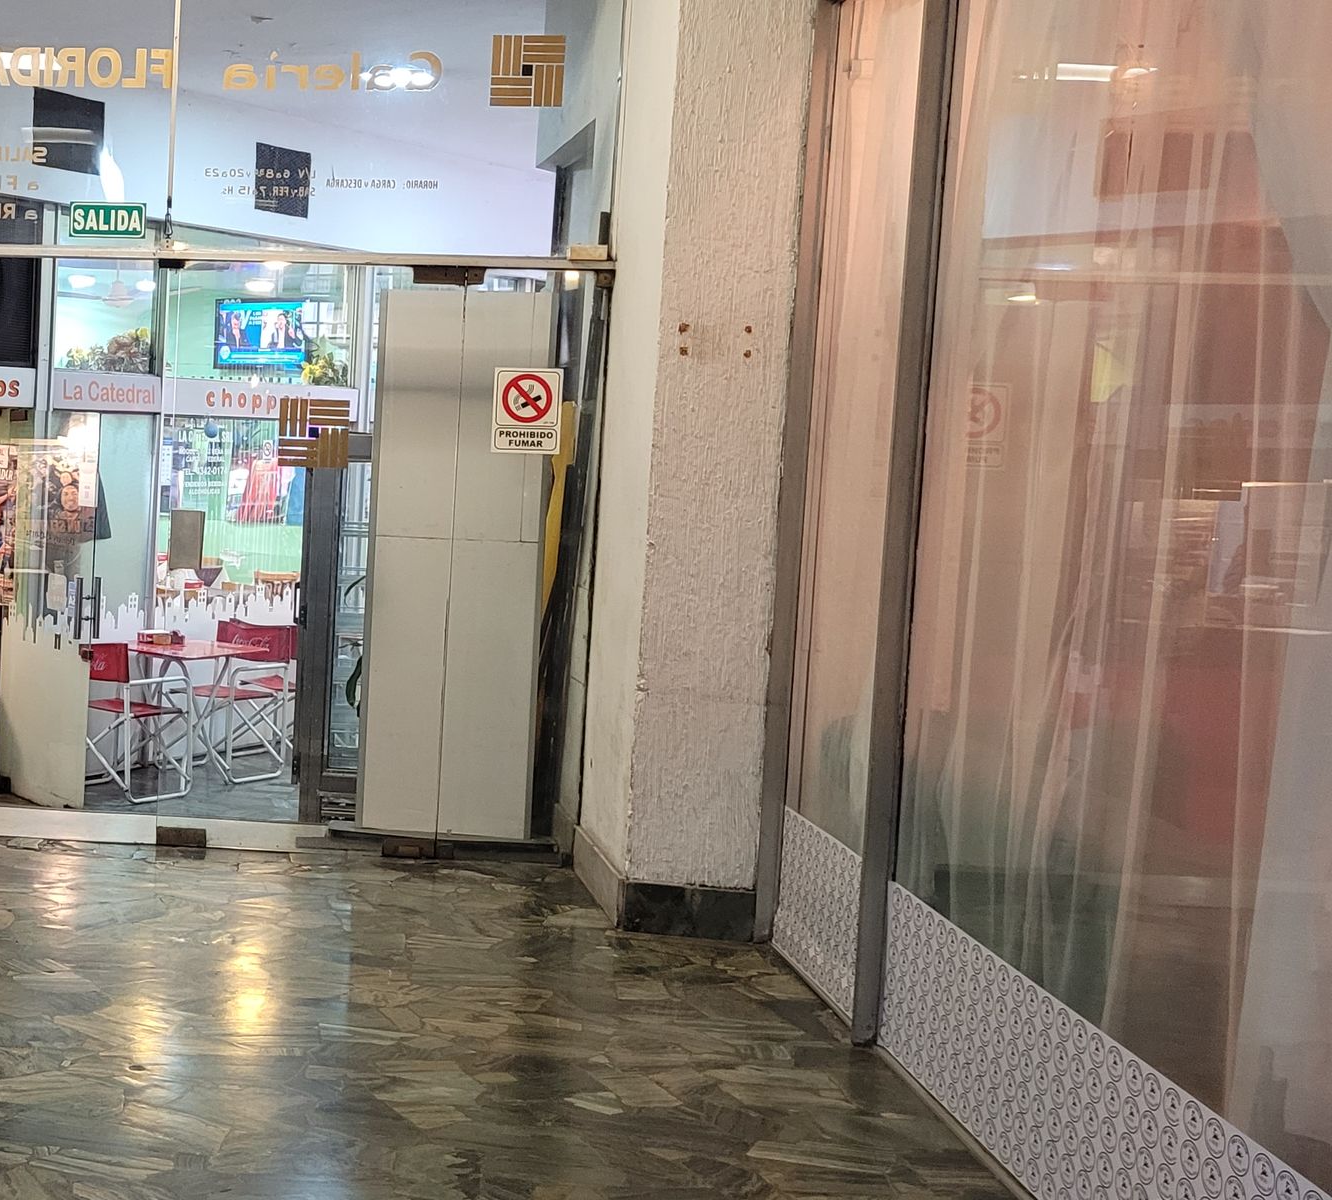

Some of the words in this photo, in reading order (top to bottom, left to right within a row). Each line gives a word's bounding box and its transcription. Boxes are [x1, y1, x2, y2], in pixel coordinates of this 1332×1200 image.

[73, 207, 142, 232] SALIDA
[63, 378, 84, 401] La
[88, 380, 155, 405] Catedral
[499, 430, 553, 439] PROHIBIDO
[508, 439, 543, 447] FUMAR
